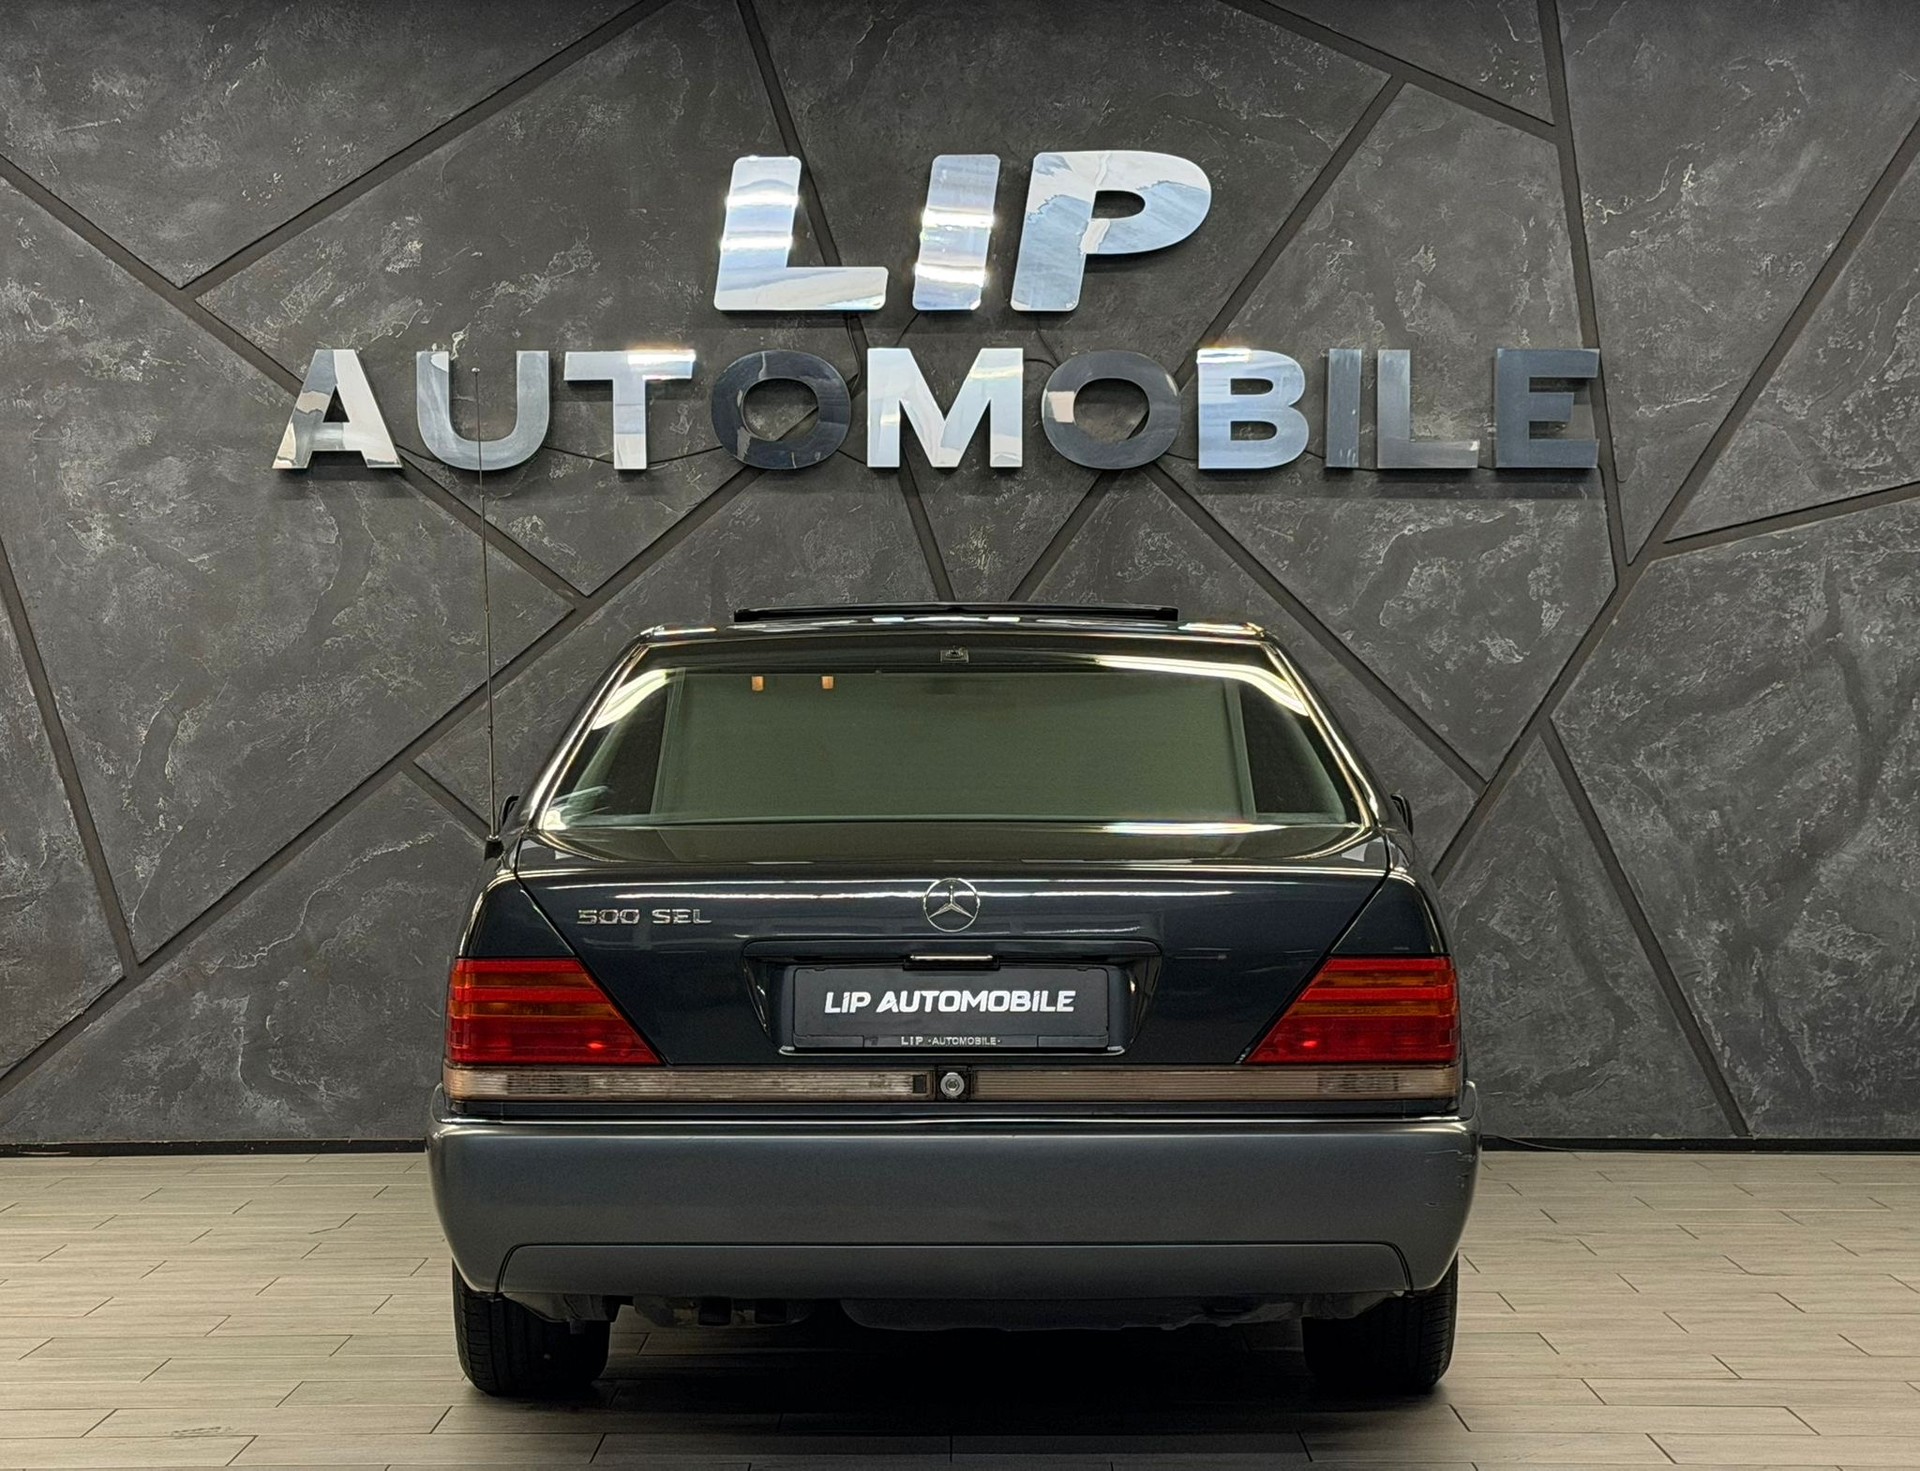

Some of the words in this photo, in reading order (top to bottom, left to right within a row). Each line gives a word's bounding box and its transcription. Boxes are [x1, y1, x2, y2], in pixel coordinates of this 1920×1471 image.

[713, 149, 1212, 313] LIP
[271, 347, 1602, 471] AUTOMOBILE
[577, 908, 640, 925] 500
[651, 908, 712, 925] SEL
[824, 991, 871, 1014] LIP
[876, 990, 1076, 1013] AUTOMOBILE
[900, 1035, 924, 1046] LIP
